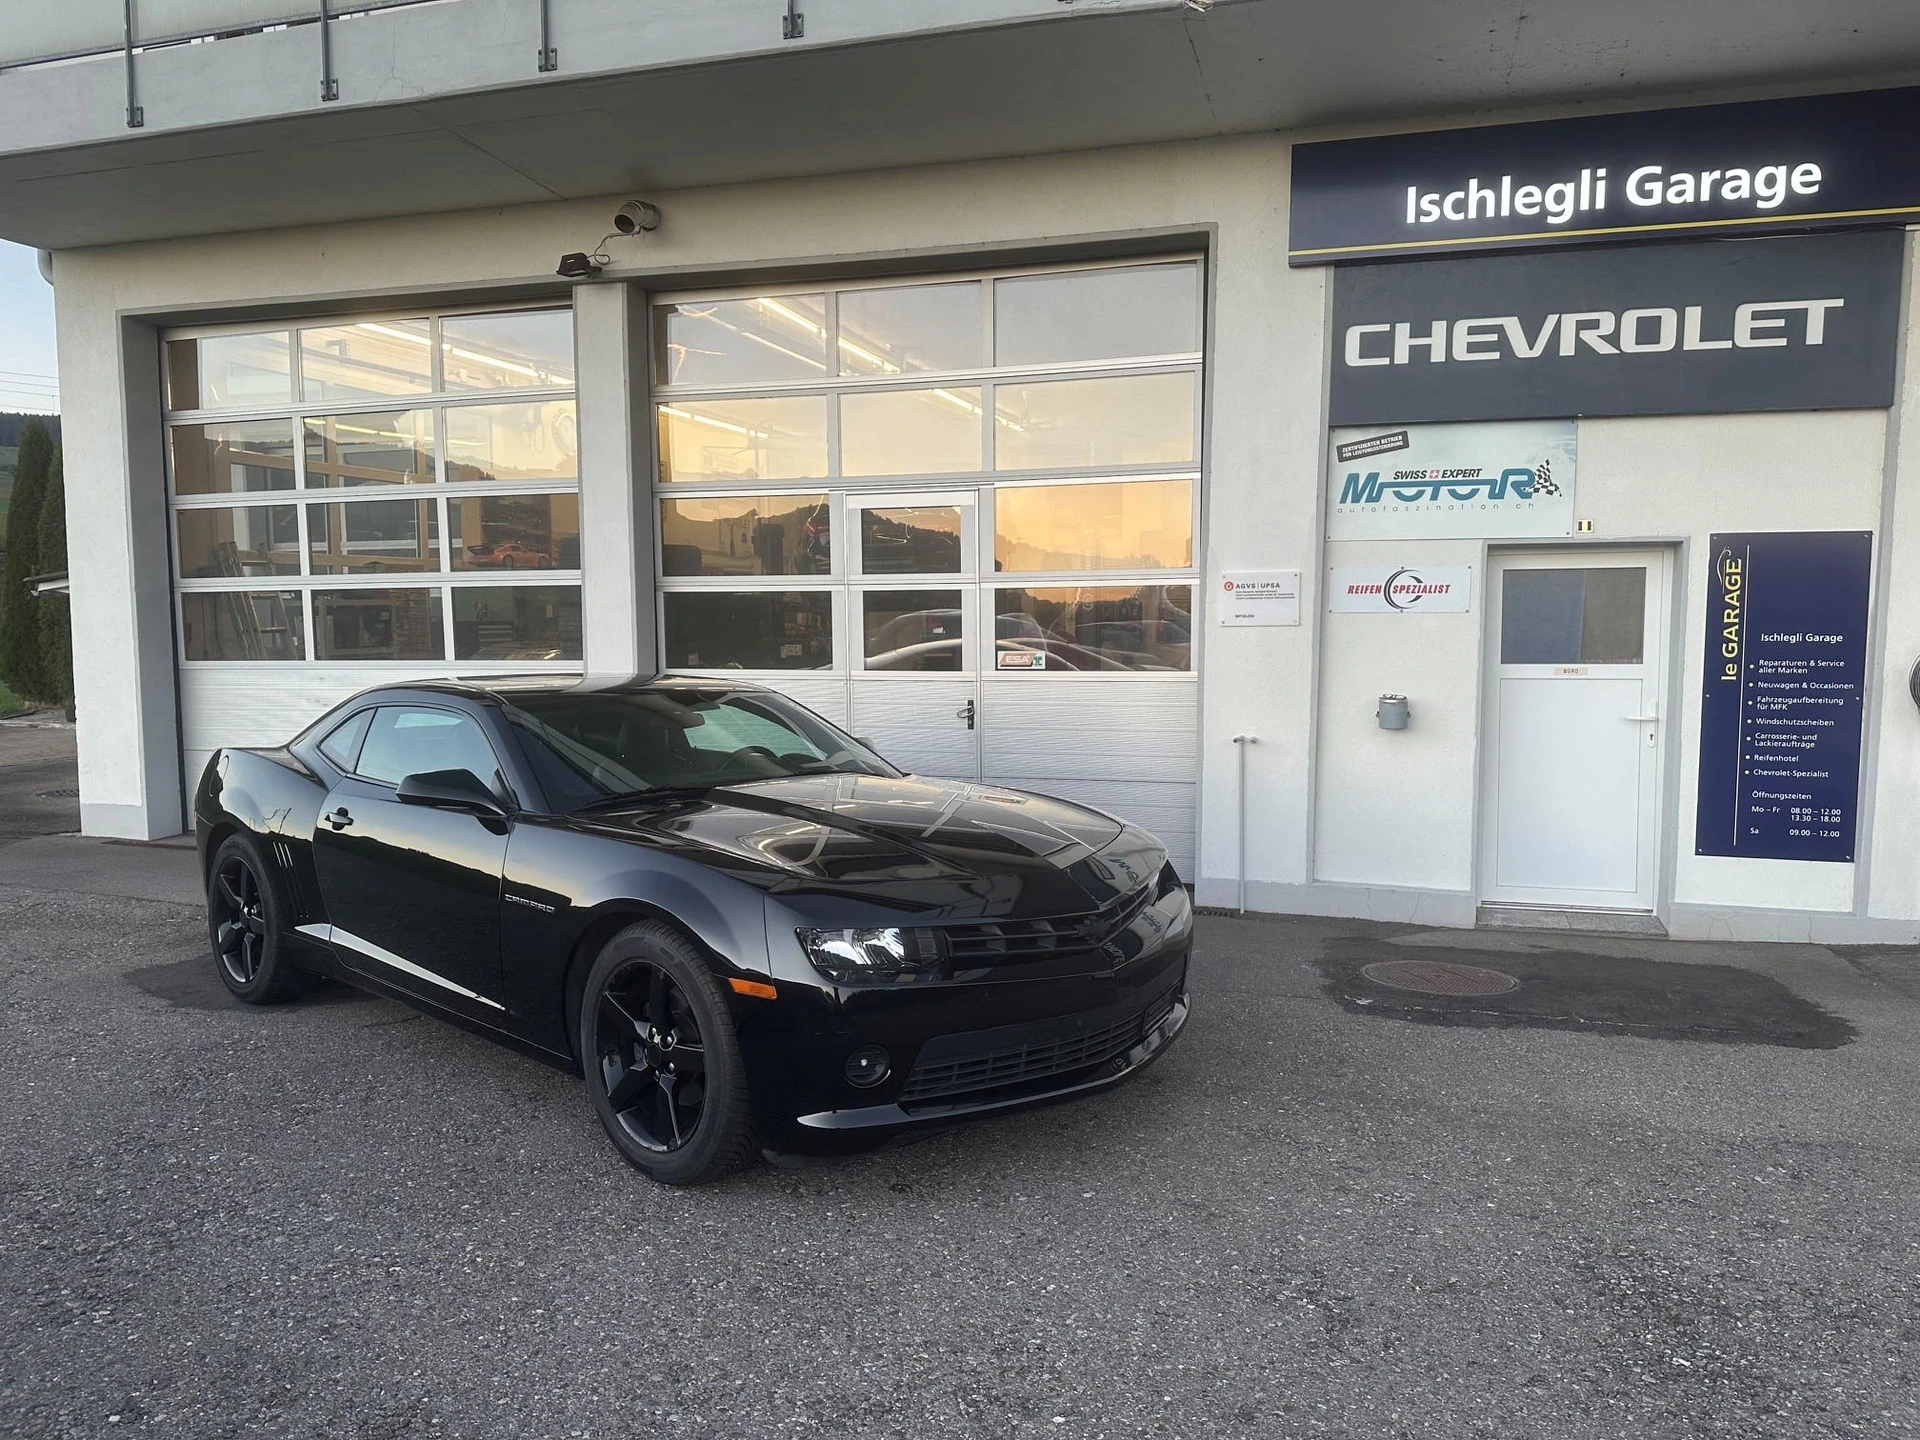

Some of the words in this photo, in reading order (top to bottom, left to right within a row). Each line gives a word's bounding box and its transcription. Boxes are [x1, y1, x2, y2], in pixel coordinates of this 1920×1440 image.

[1406, 168, 1606, 225] Ischlegli
[1625, 161, 1823, 210] Garage
[1344, 298, 1845, 368] CHEVROLET
[1393, 469, 1427, 480] SWISS
[1441, 468, 1483, 479] EXPERT
[1347, 585, 1382, 594] REIFEN
[1392, 584, 1451, 594] SPEZIALIST
[1722, 558, 1742, 658] GARAGE
[1760, 633, 1803, 643] Ischlegli
[1805, 633, 1844, 643] Garage
[1006, 655, 1029, 663] ESA
[1758, 659, 1808, 669] Reparaturen
[1817, 659, 1845, 667] Service
[1721, 663, 1737, 681] le
[1757, 681, 1799, 690] Neuwagen
[1801, 681, 1808, 689] &
[1809, 682, 1854, 690] Occasionen
[1756, 695, 1844, 706] Fahrzeugaufbereitung
[1756, 702, 1768, 710] für
[1769, 703, 1788, 711] MFK
[1755, 717, 1834, 727] Windschutzscheiben
[1754, 732, 1800, 740] Carrosserie-
[1801, 733, 1818, 741] und
[1754, 740, 1816, 749] Lackieraufträge
[1753, 754, 1799, 763] Reifenhotel
[1752, 768, 1829, 778] Chevrolet-Spezialist
[1751, 789, 1812, 800] Öffnungszeiten
[1751, 805, 1765, 813] Mo
[1790, 806, 1812, 815] 08.00
[1820, 808, 1842, 816] 12.00
[1791, 813, 1812, 822] 13.30
[1820, 815, 1841, 823] 18.00
[1750, 826, 1760, 835] Sa
[1789, 828, 1811, 837] 09.00
[1819, 830, 1840, 838] 12.00
[504, 893, 555, 913] CAMARO
